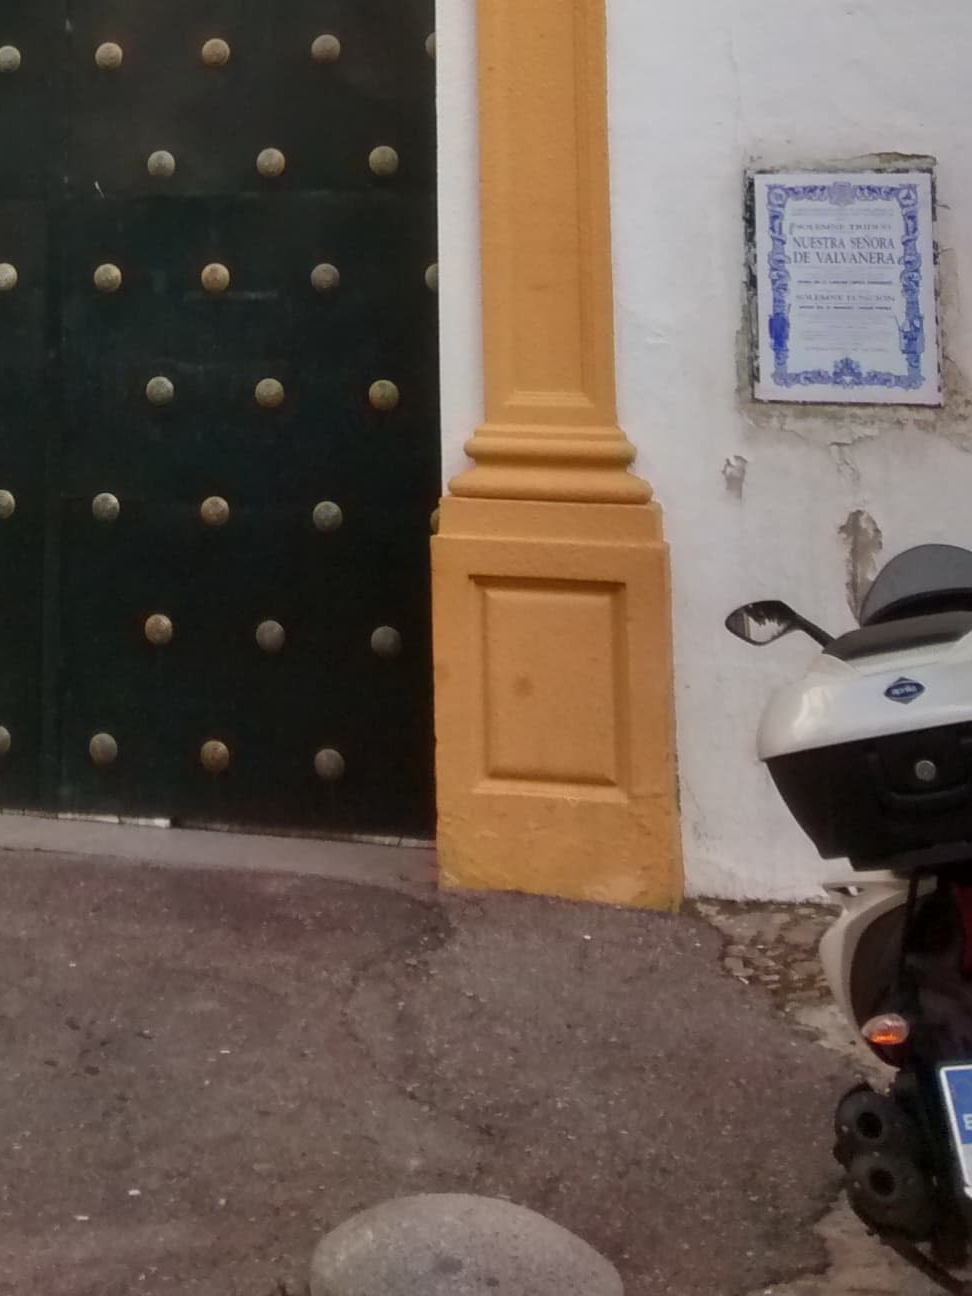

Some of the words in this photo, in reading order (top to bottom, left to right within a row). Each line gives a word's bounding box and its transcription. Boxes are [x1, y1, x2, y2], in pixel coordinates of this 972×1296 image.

[793, 237, 846, 249] NUESTRA
[850, 235, 895, 250] SEÑORA
[793, 251, 811, 263] DE
[816, 251, 896, 264] VALVANERA
